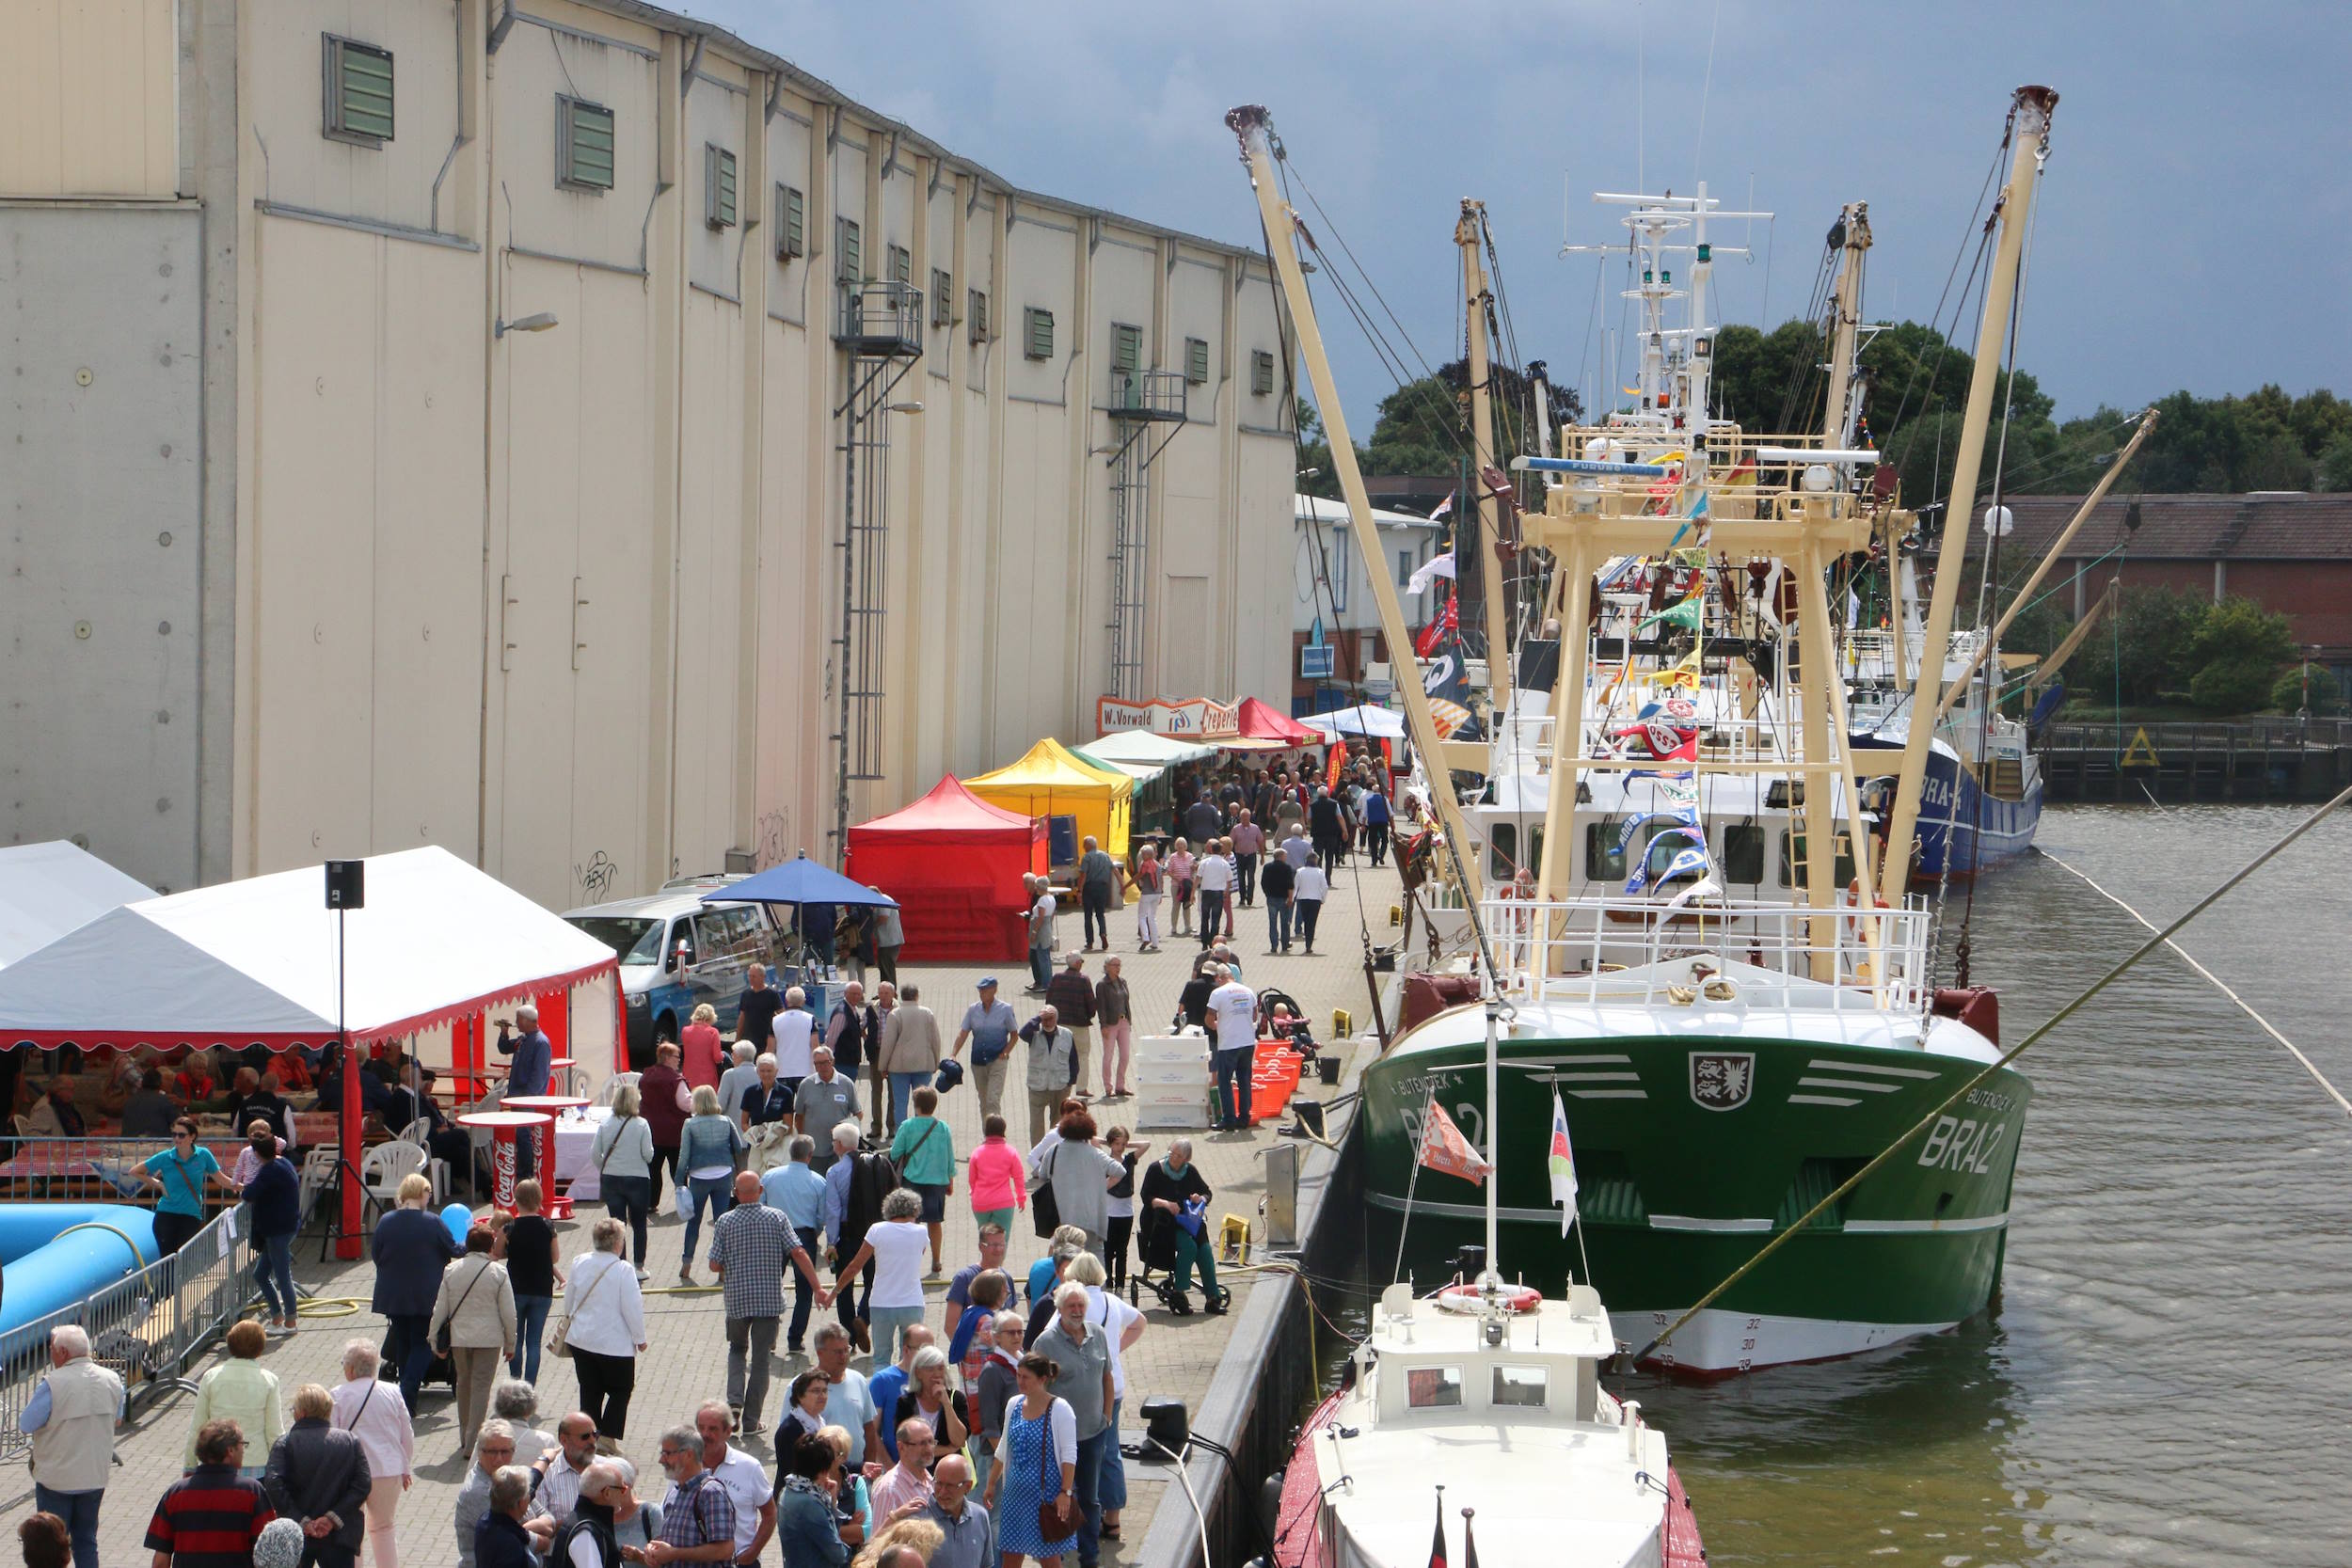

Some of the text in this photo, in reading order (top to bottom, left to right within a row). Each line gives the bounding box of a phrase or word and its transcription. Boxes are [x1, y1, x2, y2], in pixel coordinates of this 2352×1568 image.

[1573, 462, 1622, 471] FURUNO
[1399, 1102, 1487, 1156] B2
[1917, 1115, 2006, 1175] BRA2
[1746, 1319, 1761, 1330] 32
[1741, 1338, 1756, 1351] 30
